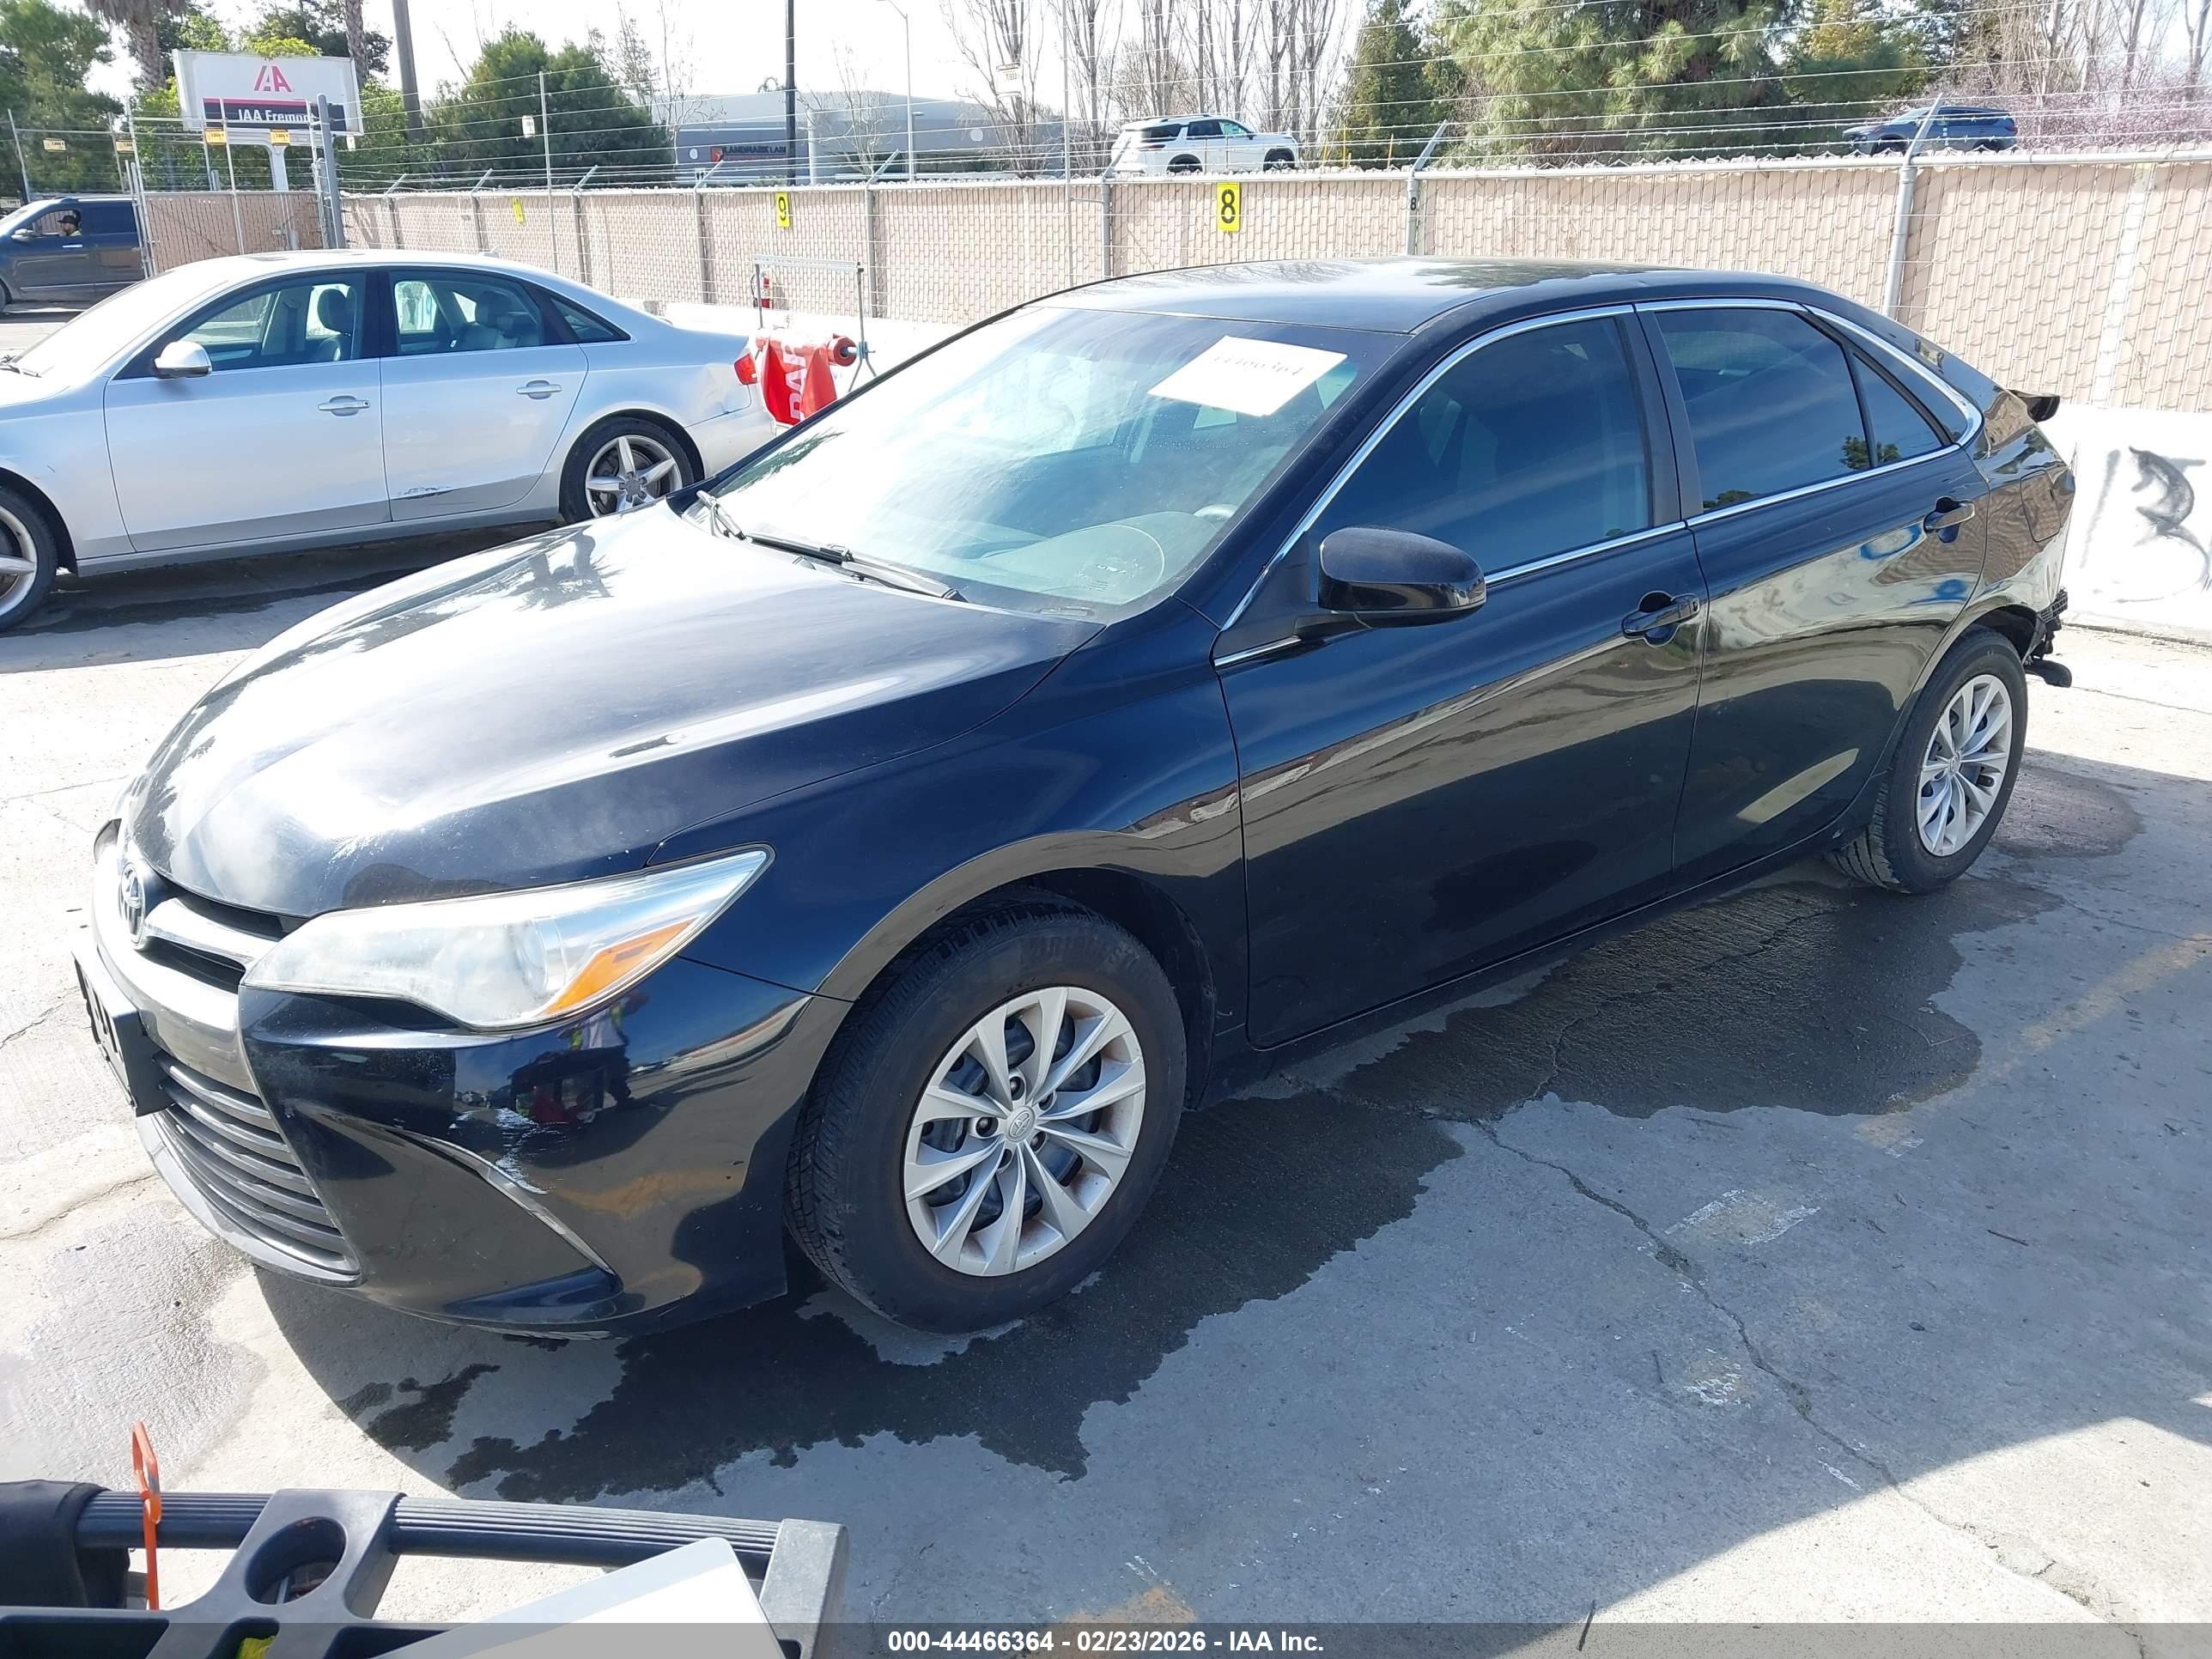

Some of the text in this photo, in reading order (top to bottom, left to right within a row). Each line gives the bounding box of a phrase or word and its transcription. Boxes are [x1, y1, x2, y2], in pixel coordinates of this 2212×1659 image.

[238, 109, 263, 121] IAA
[778, 196, 787, 222] 9
[1220, 188, 1237, 224] 8
[1410, 197, 1417, 211] 8
